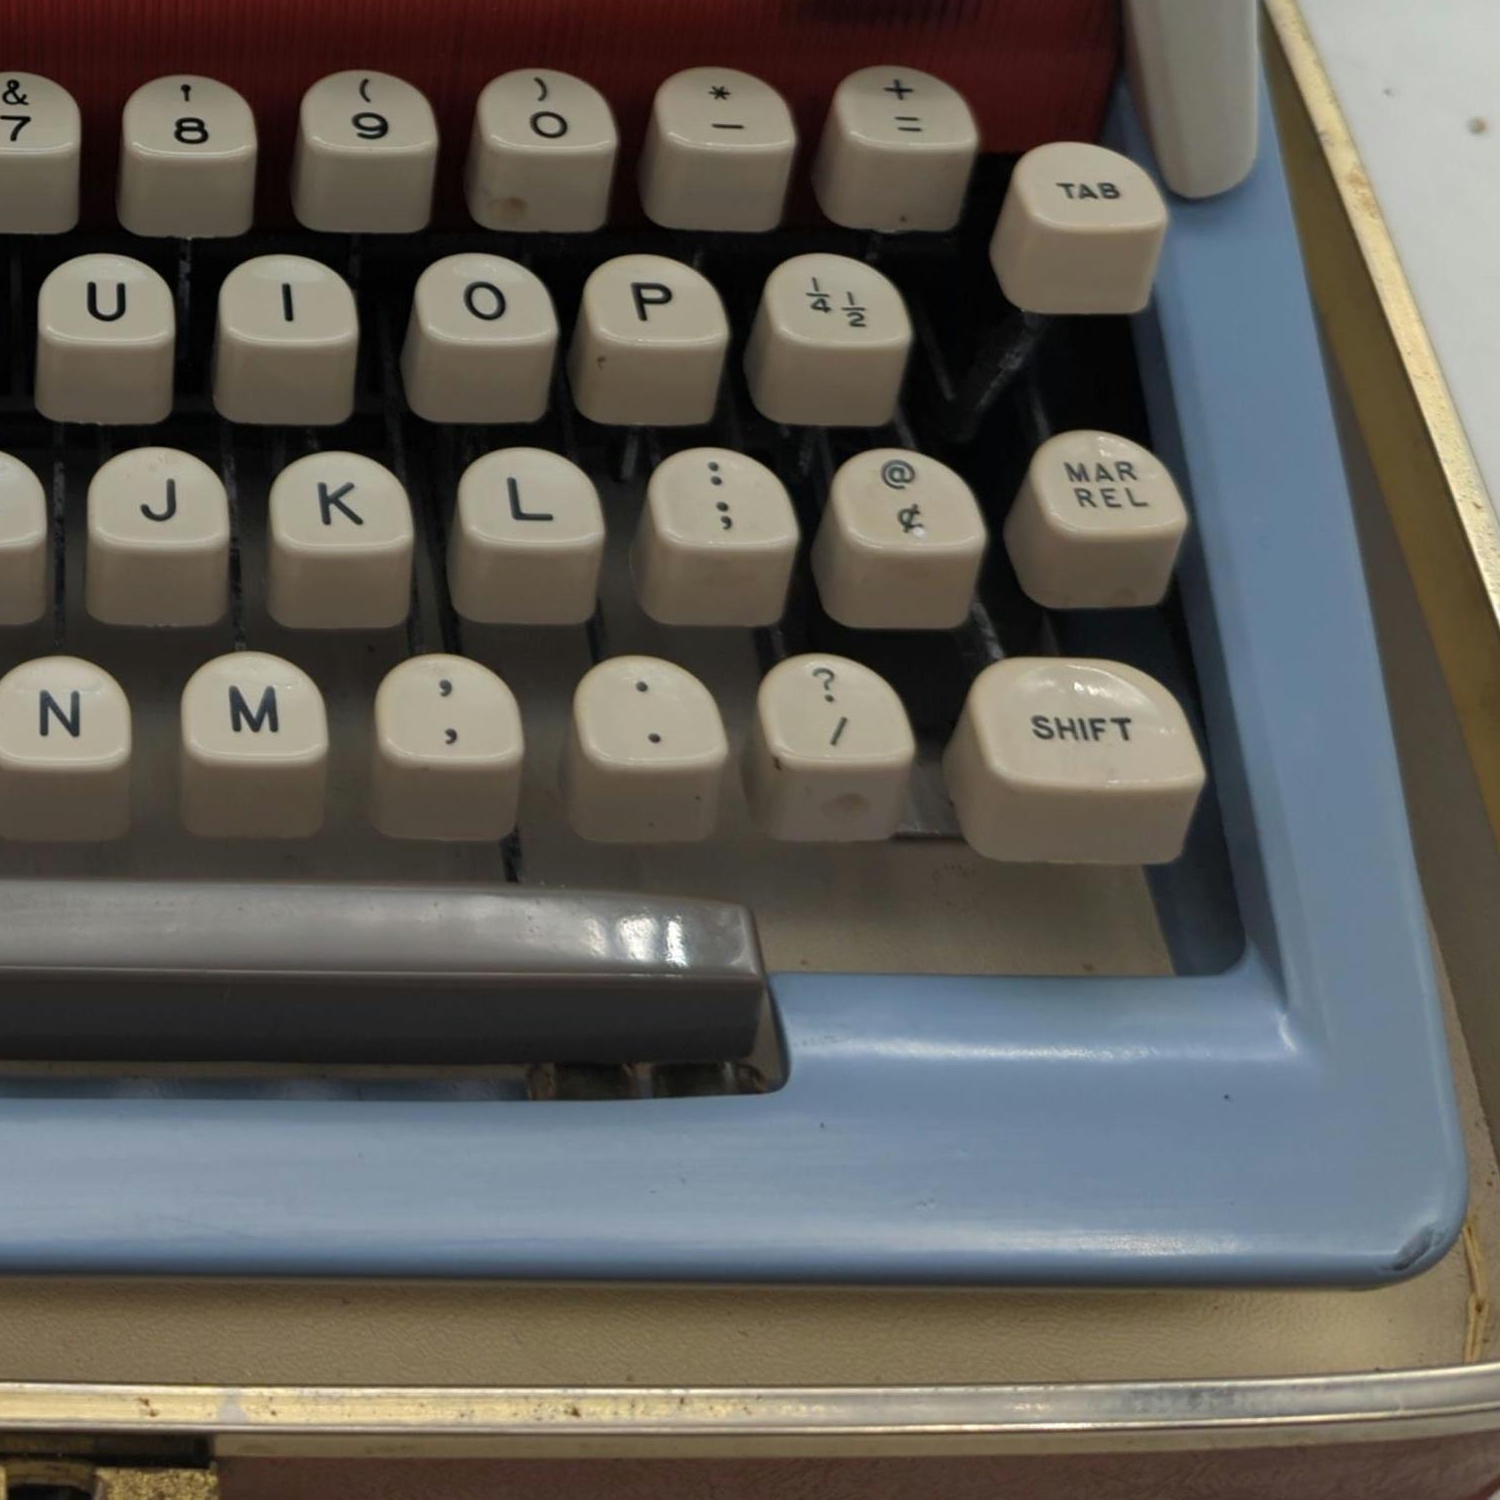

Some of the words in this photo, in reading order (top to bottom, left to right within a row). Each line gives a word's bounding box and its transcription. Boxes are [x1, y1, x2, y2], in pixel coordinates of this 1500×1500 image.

[1, 77, 31, 106] &
[883, 78, 915, 101] +
[173, 116, 210, 145] 8
[351, 111, 390, 140] 9
[529, 110, 569, 139] 0
[1056, 182, 1121, 200] TAB
[86, 281, 127, 323] U
[281, 283, 295, 323] I
[463, 281, 507, 322] O
[630, 282, 673, 322] P
[880, 459, 916, 491] @
[1063, 461, 1138, 483] MAR
[140, 478, 177, 523] J
[317, 482, 364, 526] K
[506, 477, 554, 522] L
[1073, 487, 1149, 509] REL
[897, 503, 924, 534] ¢
[812, 667, 836, 704] ?
[39, 690, 81, 738] N
[228, 685, 280, 734] M
[1031, 715, 1132, 742] SHIFT
